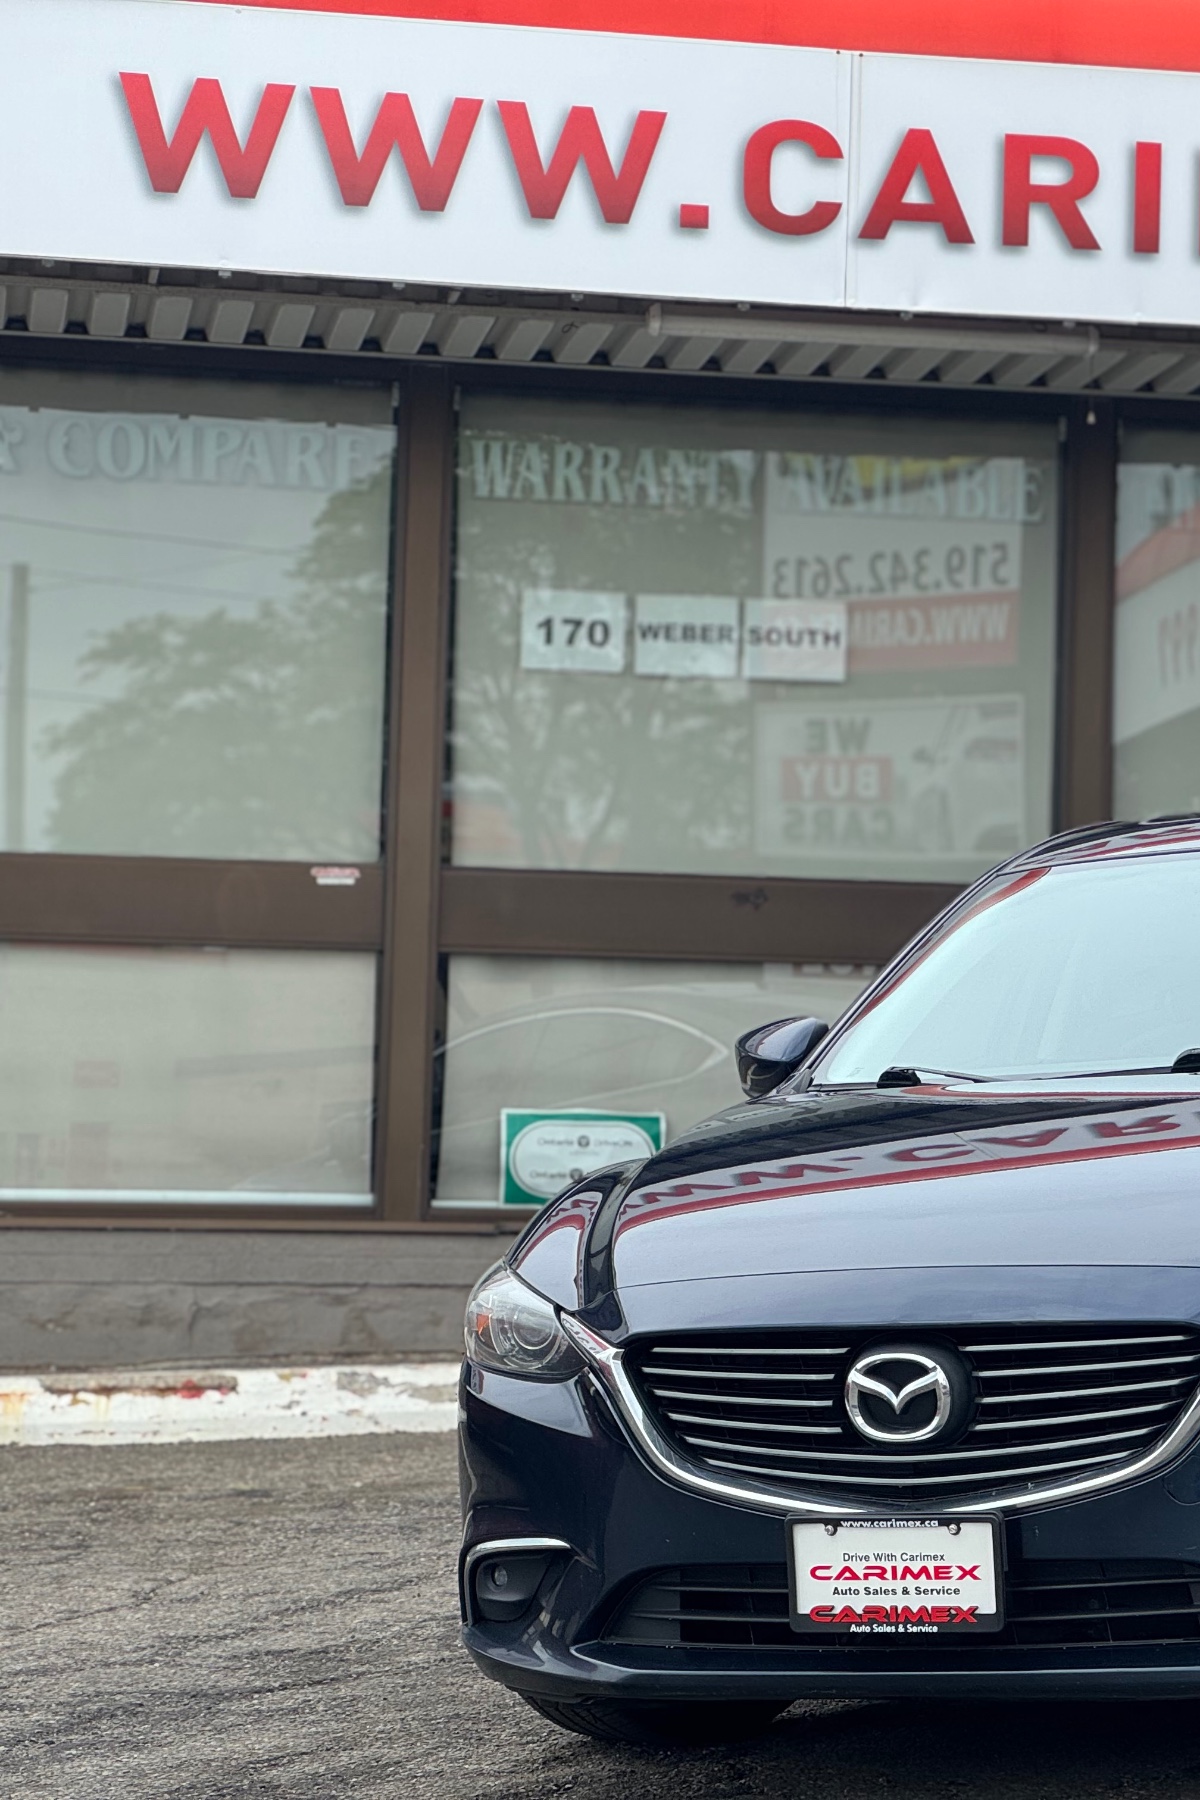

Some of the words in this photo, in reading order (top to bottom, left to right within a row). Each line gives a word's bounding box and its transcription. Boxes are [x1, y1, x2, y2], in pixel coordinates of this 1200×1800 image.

[471, 439, 758, 509] WARRANTY
[535, 617, 611, 648] 170
[636, 620, 735, 646] WEBER
[747, 626, 841, 650] SOUTH
[840, 1519, 939, 1528] www.carimex.ca
[842, 1552, 870, 1562] Drive
[873, 1552, 897, 1562] With
[900, 1552, 945, 1562] Carimex
[810, 1565, 982, 1581] CARIMEX
[832, 1586, 860, 1596] Auto
[864, 1586, 897, 1596] Sales
[901, 1586, 911, 1595] &
[914, 1586, 960, 1596] Service
[809, 1605, 979, 1623] CARIMEX
[850, 1624, 870, 1633] Auto
[872, 1624, 896, 1633] Sales
[898, 1624, 905, 1632] &
[907, 1624, 938, 1633] Service
